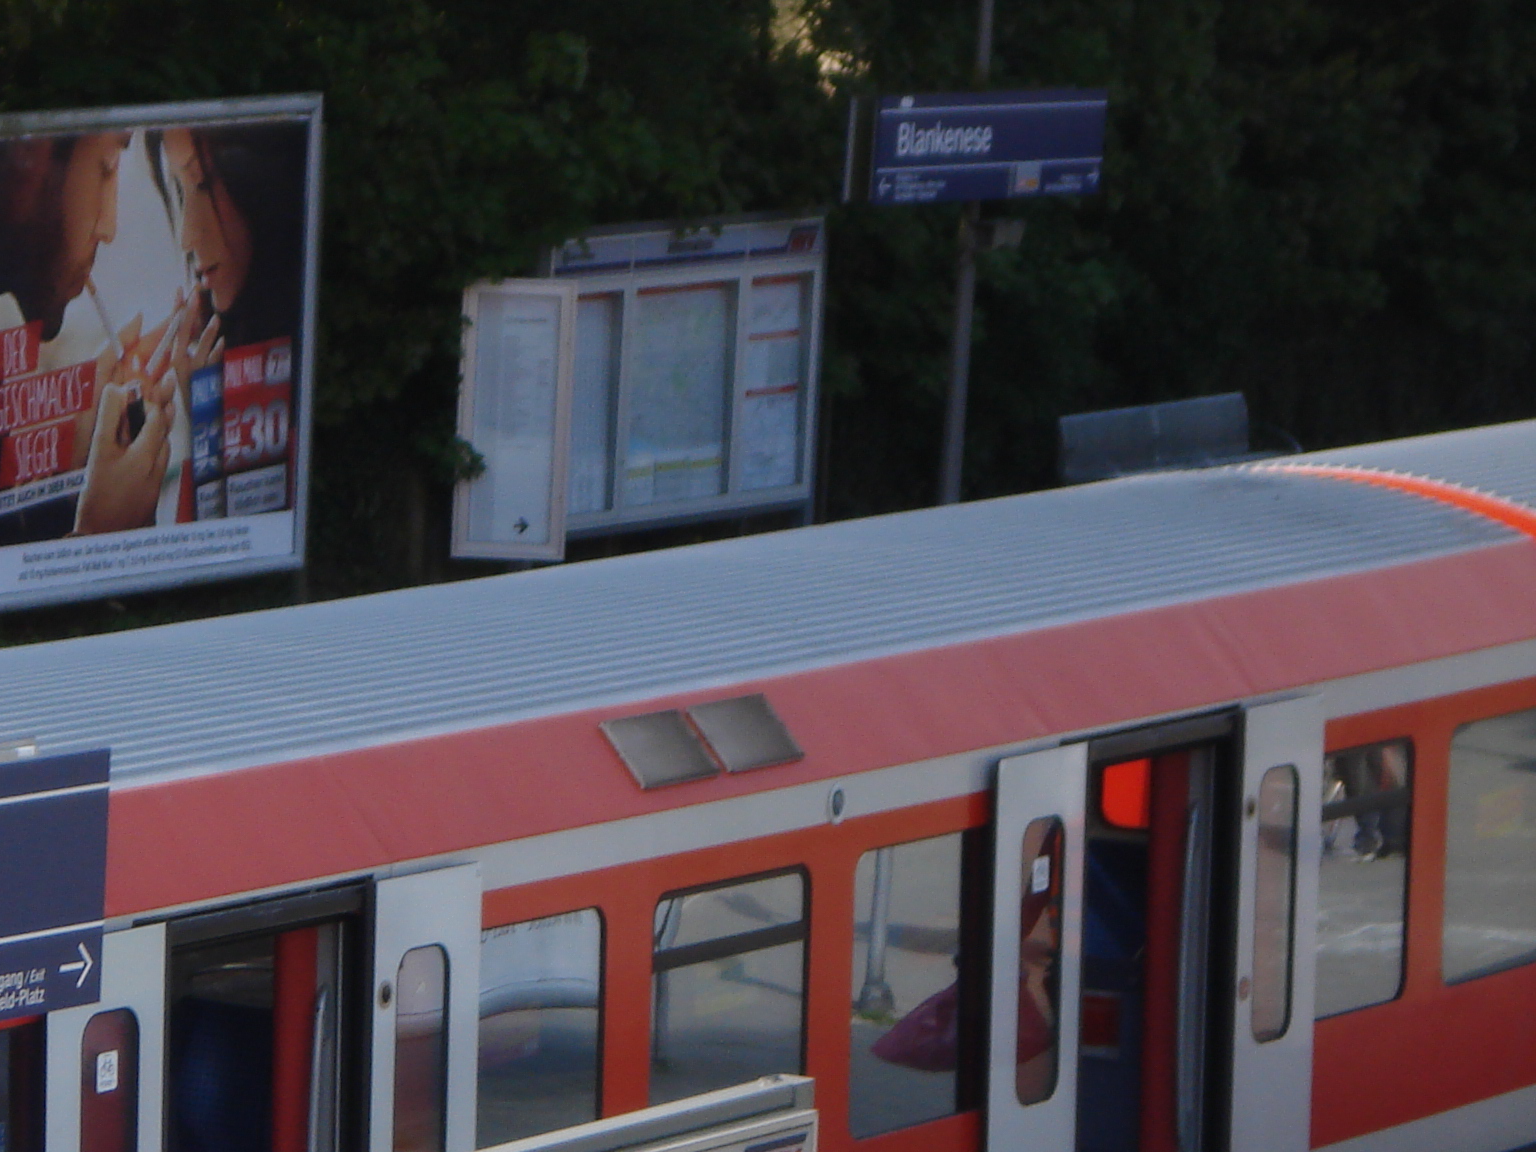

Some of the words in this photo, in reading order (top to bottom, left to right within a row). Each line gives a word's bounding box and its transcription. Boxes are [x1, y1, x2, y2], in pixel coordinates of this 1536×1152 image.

[896, 120, 994, 157] Blankenese
[2, 327, 28, 377] DER
[14, 427, 59, 482] SIEGER
[241, 398, 289, 463] 30
